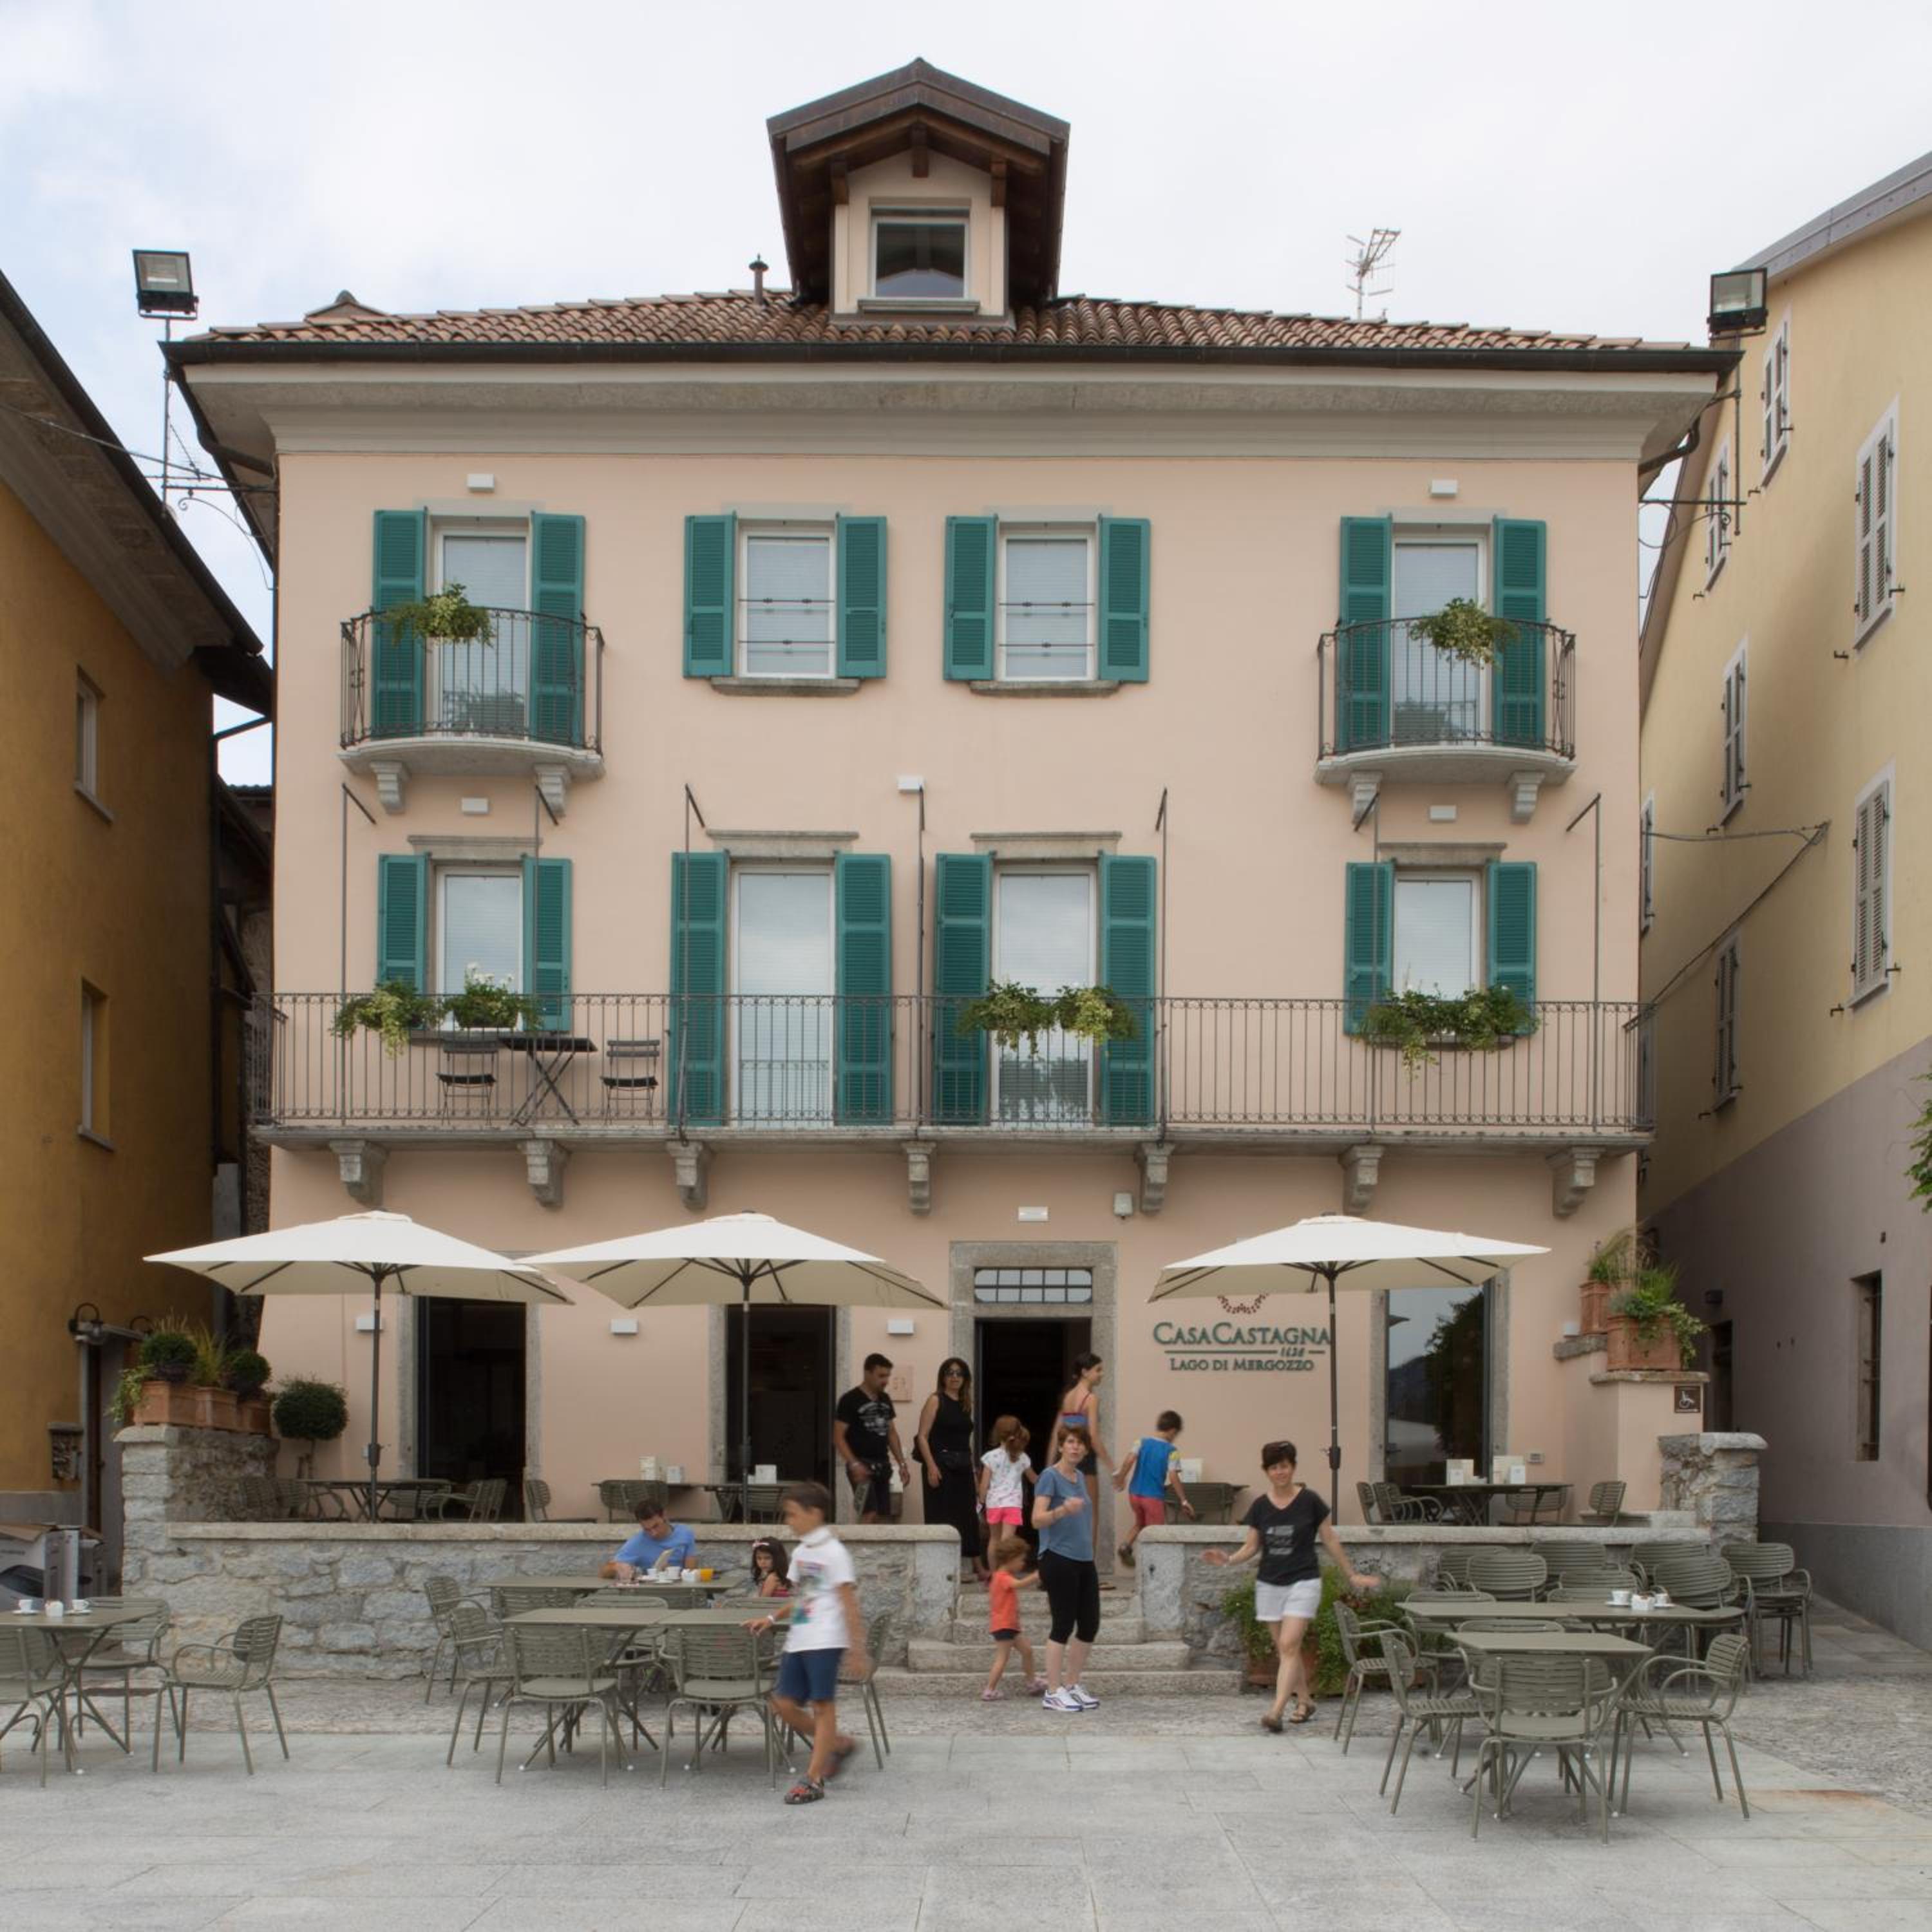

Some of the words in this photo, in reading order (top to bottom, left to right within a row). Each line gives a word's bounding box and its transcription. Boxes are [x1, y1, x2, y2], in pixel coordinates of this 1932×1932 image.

[1170, 1358, 1208, 1371] LAGO
[1213, 1359, 1228, 1371] DI
[1233, 1358, 1314, 1371] MERGOZZO
